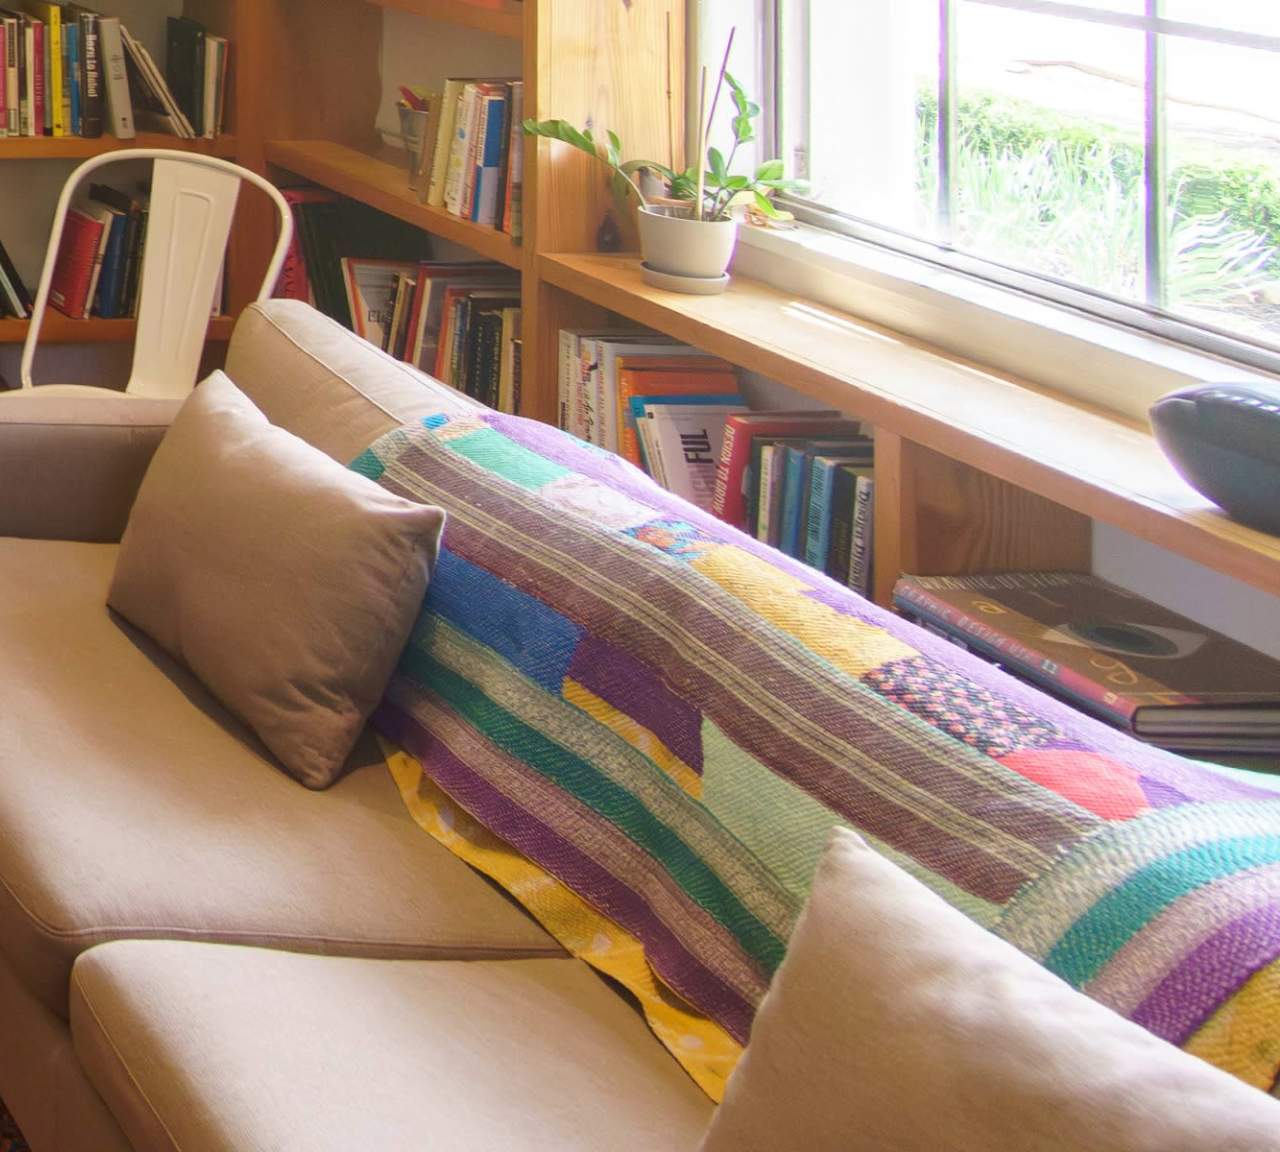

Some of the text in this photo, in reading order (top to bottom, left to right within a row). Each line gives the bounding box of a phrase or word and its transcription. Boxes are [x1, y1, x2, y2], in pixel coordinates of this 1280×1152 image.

[86, 35, 98, 58] Born
[86, 59, 98, 70] to
[711, 423, 736, 515] DESIGN TO GROW
[899, 584, 952, 620] GRAPHIC
[957, 616, 1007, 648] DESIGN
